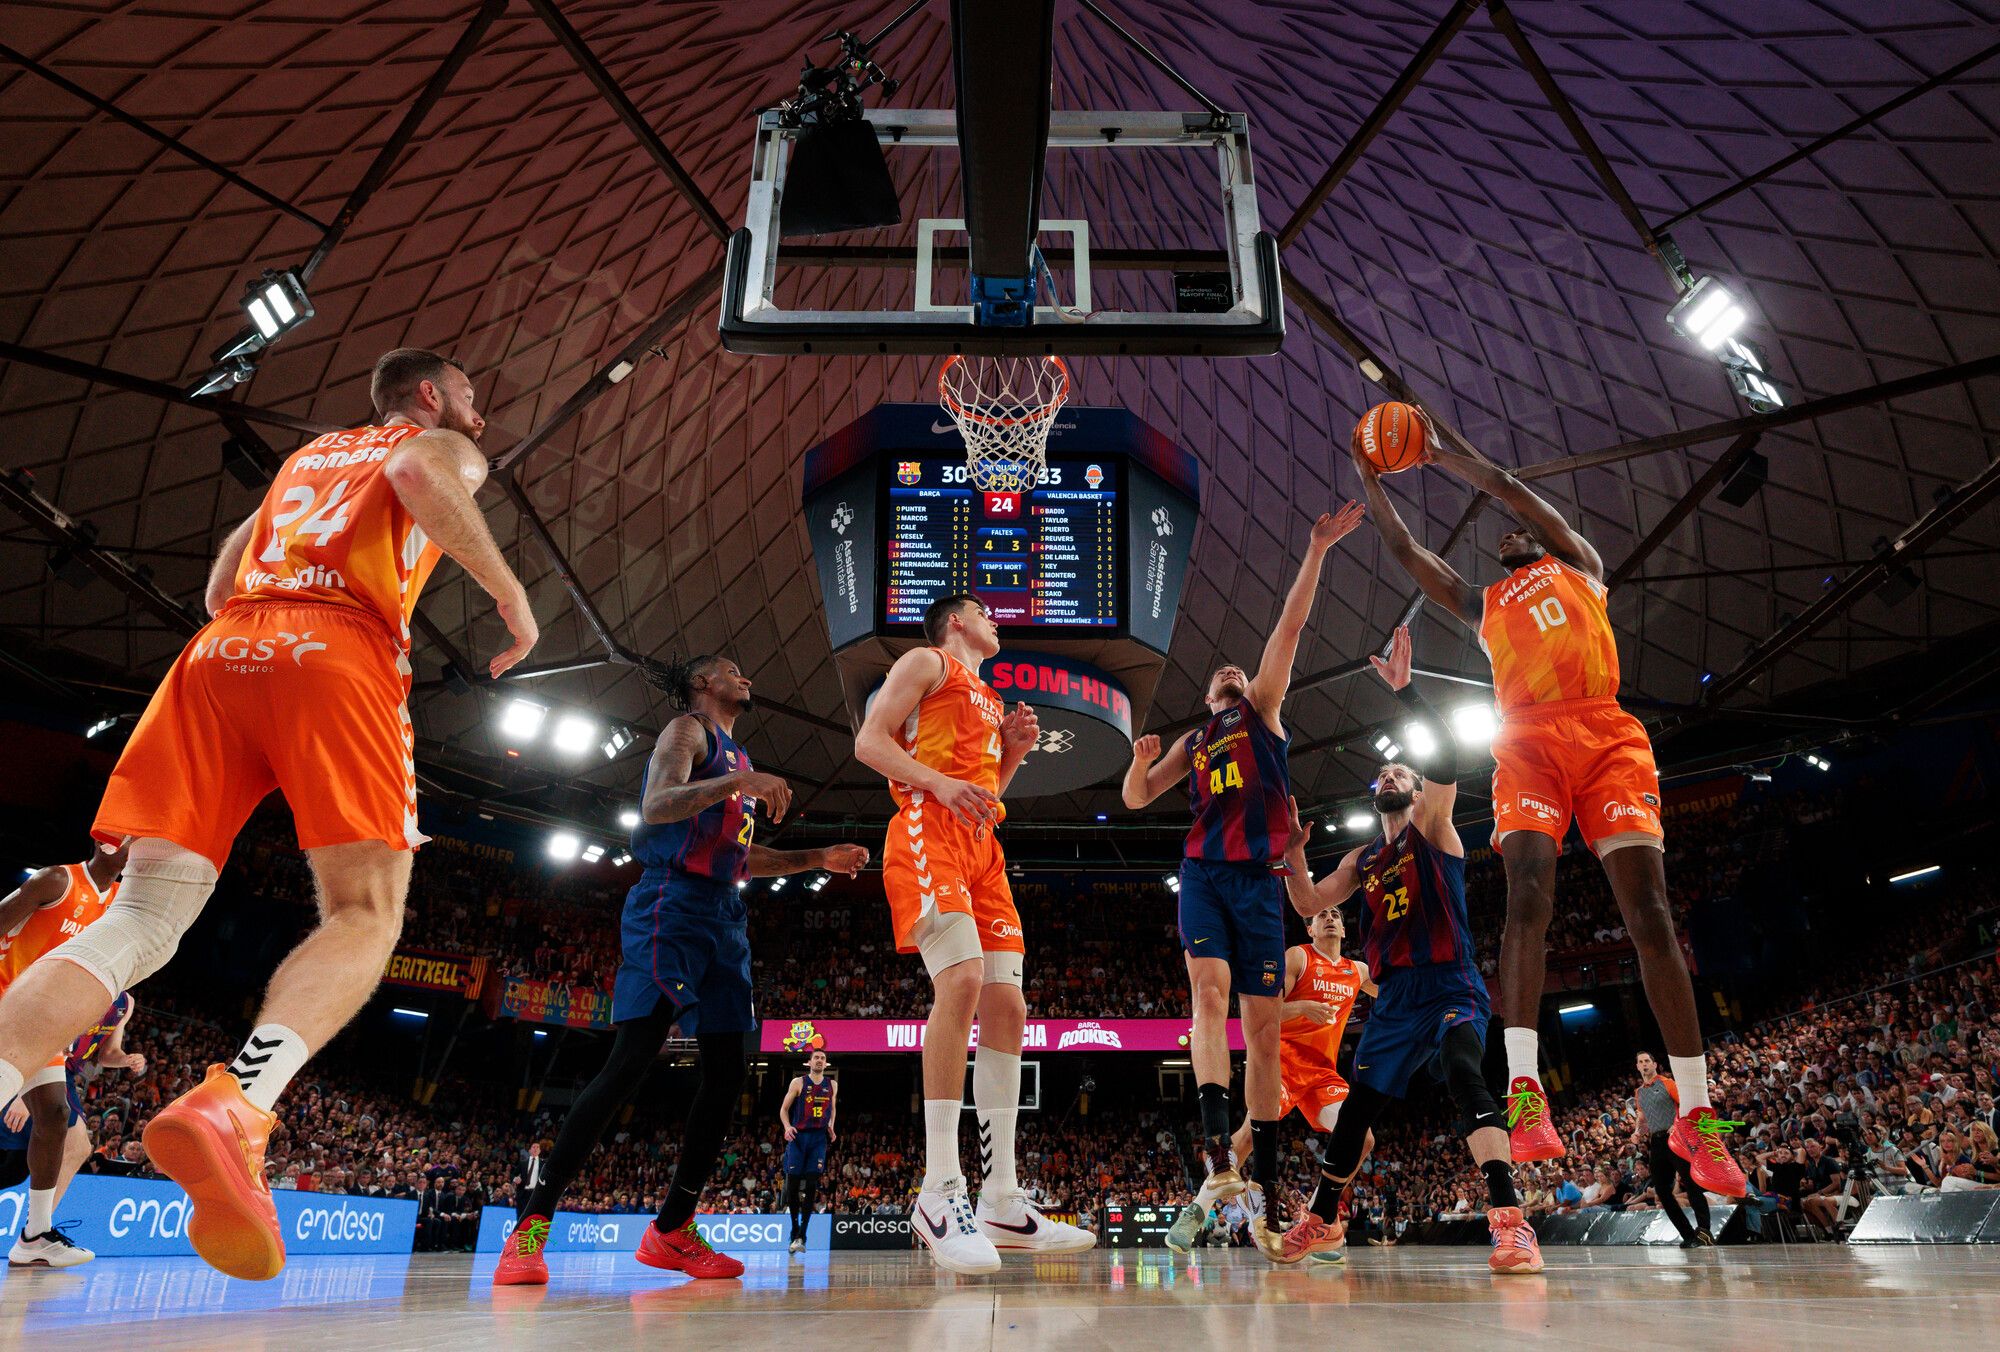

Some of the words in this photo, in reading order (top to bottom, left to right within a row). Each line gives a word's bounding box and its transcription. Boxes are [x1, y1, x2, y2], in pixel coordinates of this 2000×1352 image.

[1363, 408, 1378, 454] Wilson
[291, 447, 389, 474] PAMESA
[942, 466, 967, 483] 30
[991, 498, 1014, 512] 24
[259, 480, 352, 562] 24
[984, 540, 994, 551] 4
[1012, 540, 1020, 552] 3
[834, 542, 846, 597] Sanitària
[844, 540, 858, 614] Assistència
[1146, 540, 1160, 592] Sanitària
[986, 574, 992, 584] 1
[1012, 574, 1019, 585] 1
[1152, 544, 1168, 619] Assistència
[1517, 576, 1554, 602] BASKET
[1529, 597, 1567, 632] 10
[190, 636, 277, 663] MGS
[225, 663, 275, 674] Seguros
[992, 662, 1109, 709] SOM-HI
[987, 732, 1002, 763] 4
[1207, 730, 1249, 753] Assistència
[1210, 761, 1244, 795] 44
[1521, 797, 1560, 819] PULEVA
[738, 812, 754, 848] 21
[1382, 886, 1410, 921] 23
[385, 955, 458, 986] ERITXELL
[1313, 979, 1354, 998] VALENCIA
[886, 1024, 916, 1047] VIU
[1058, 1028, 1122, 1049] ROOKIES
[1077, 1022, 1100, 1030] BARÇA
[812, 1106, 823, 1118] 13
[296, 1200, 385, 1241] endesa
[568, 1217, 620, 1243] endesa
[697, 1217, 783, 1243] ndesa
[835, 1217, 910, 1234] endesa
[1109, 1213, 1123, 1222] 30
[1133, 1213, 1157, 1222] 4:09
[1112, 1235, 1119, 1244] 4
